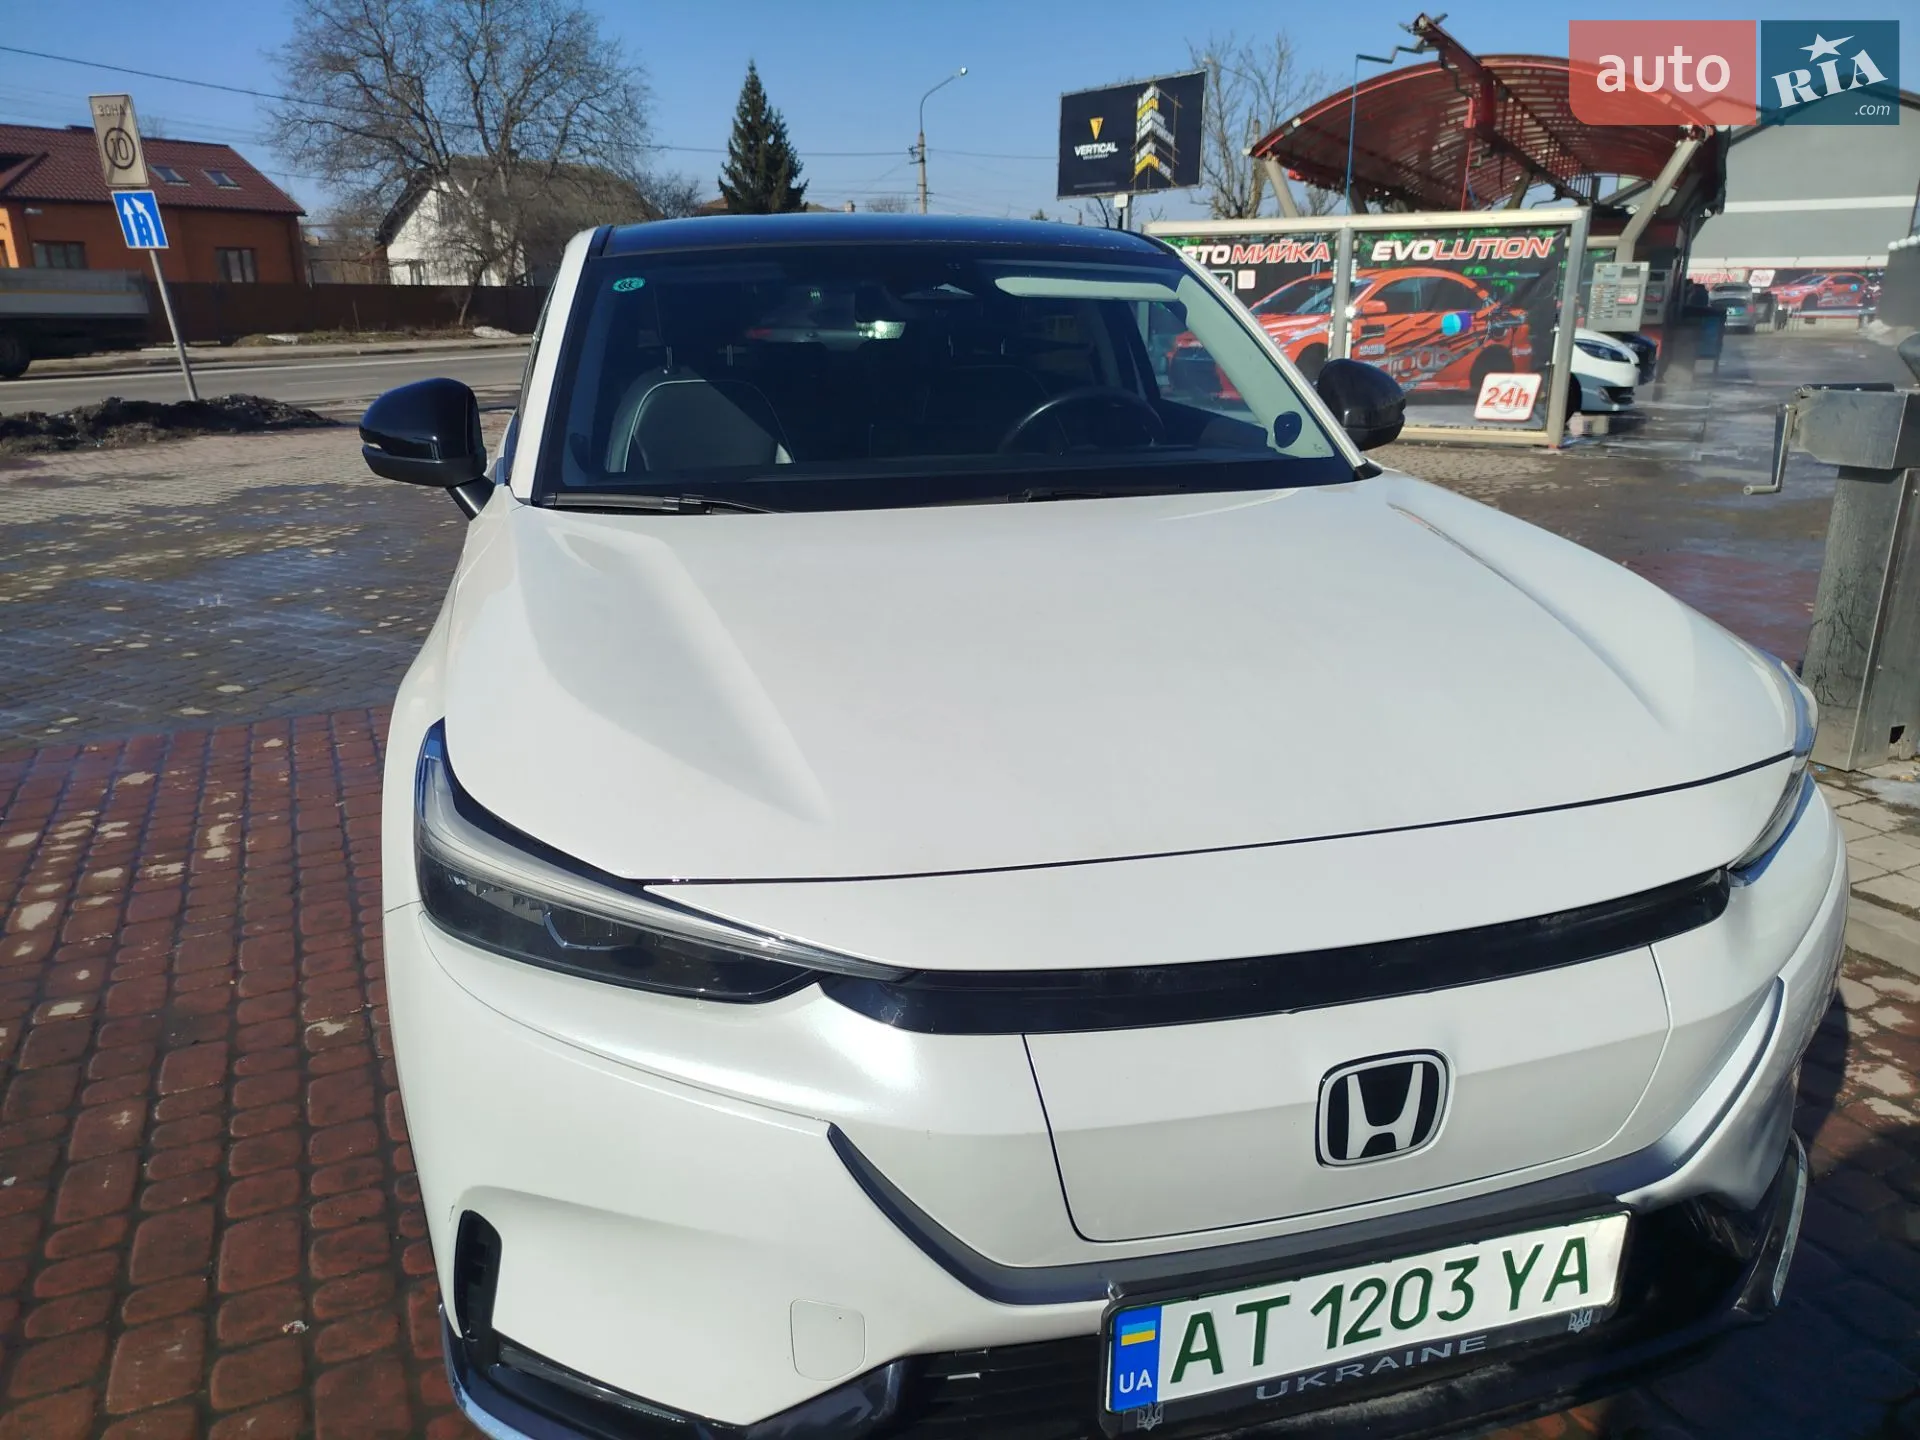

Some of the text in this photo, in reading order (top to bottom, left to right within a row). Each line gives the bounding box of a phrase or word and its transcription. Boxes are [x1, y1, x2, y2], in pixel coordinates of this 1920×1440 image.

[1074, 141, 1119, 157] VERTICAL
[1371, 236, 1554, 261] EVOLUTION
[1483, 386, 1529, 408] 24h
[1169, 1236, 1590, 1384] AT 1203 YA
[1255, 1335, 1488, 1401] UKRAINE
[1118, 1368, 1153, 1394] UA
